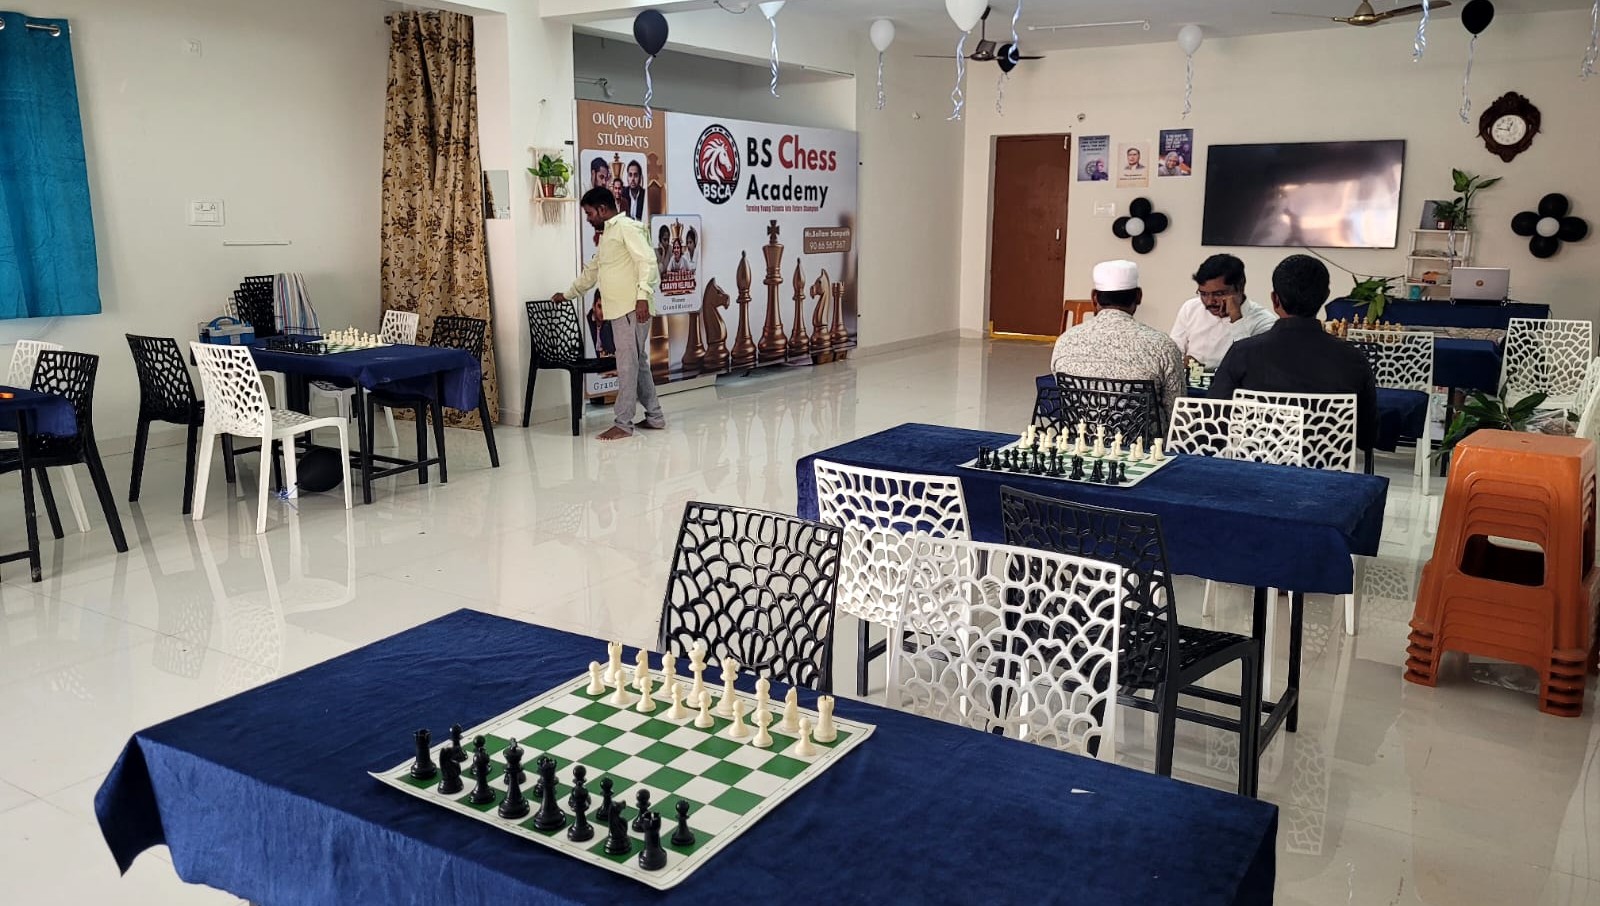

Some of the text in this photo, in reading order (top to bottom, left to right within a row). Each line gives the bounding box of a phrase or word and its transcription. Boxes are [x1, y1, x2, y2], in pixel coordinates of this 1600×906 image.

[592, 111, 653, 130] OUR PROUD
[597, 132, 649, 149] STUDENTS
[747, 134, 837, 171] BS Chess
[703, 183, 732, 199] BSCA
[746, 174, 828, 208] Academy
